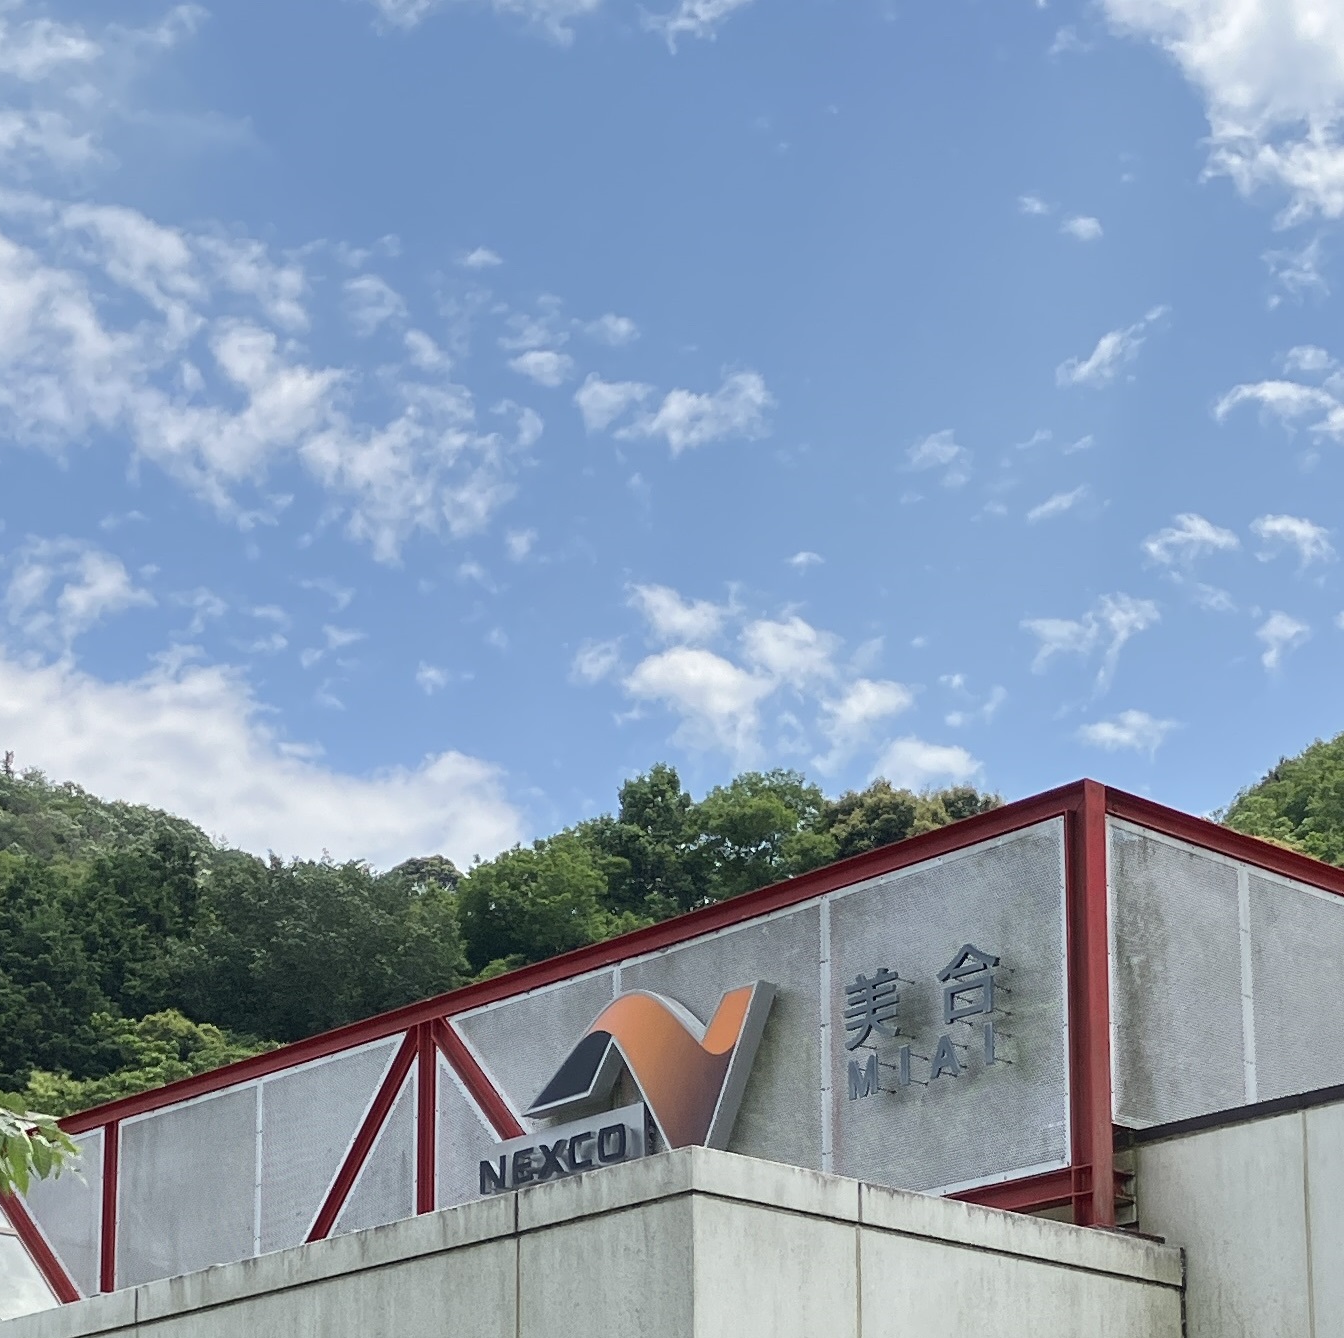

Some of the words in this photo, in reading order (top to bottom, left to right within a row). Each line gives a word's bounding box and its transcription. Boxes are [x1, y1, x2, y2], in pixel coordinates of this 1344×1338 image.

[845, 944, 1000, 1050] 美合
[847, 1023, 996, 1100] MIAI
[479, 1123, 626, 1195] NEXCO
